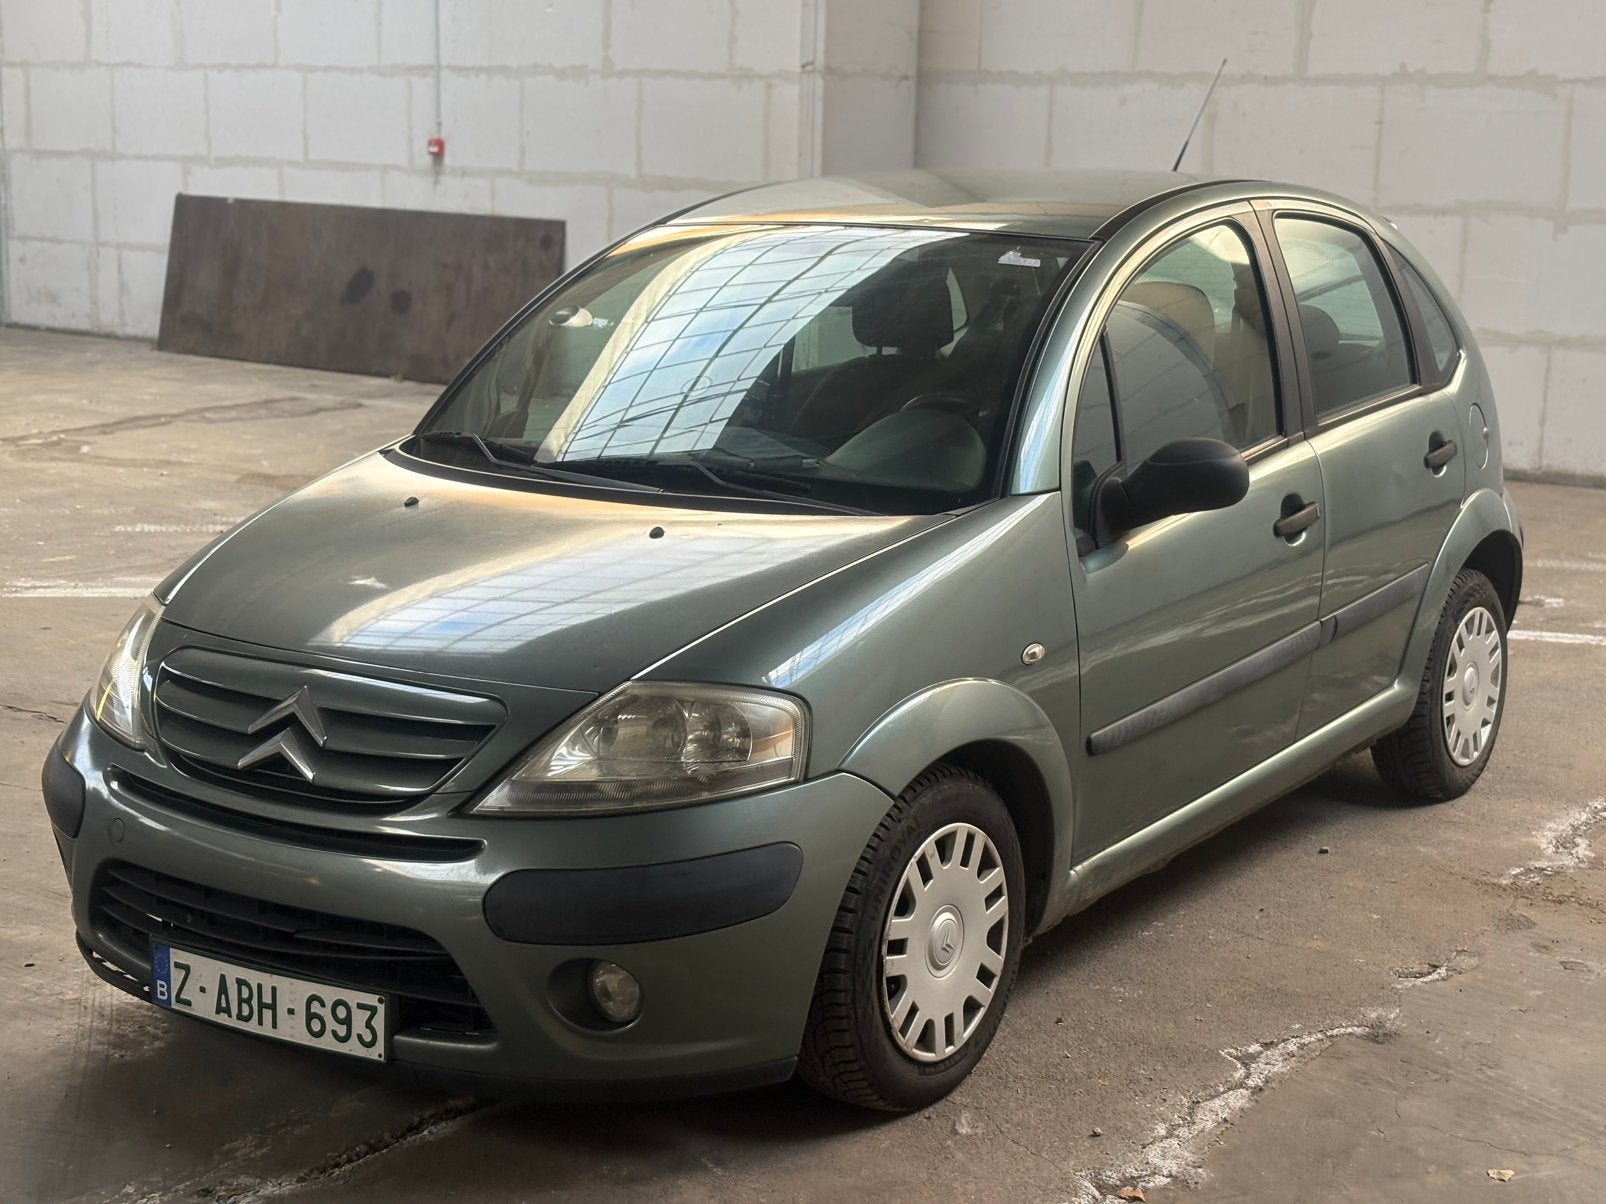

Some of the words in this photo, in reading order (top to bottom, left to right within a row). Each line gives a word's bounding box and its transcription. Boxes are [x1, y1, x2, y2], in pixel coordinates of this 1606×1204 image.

[866, 816, 923, 921] UNIROYAL
[156, 980, 168, 1000] B
[173, 961, 378, 1048] Z-ABH-693
